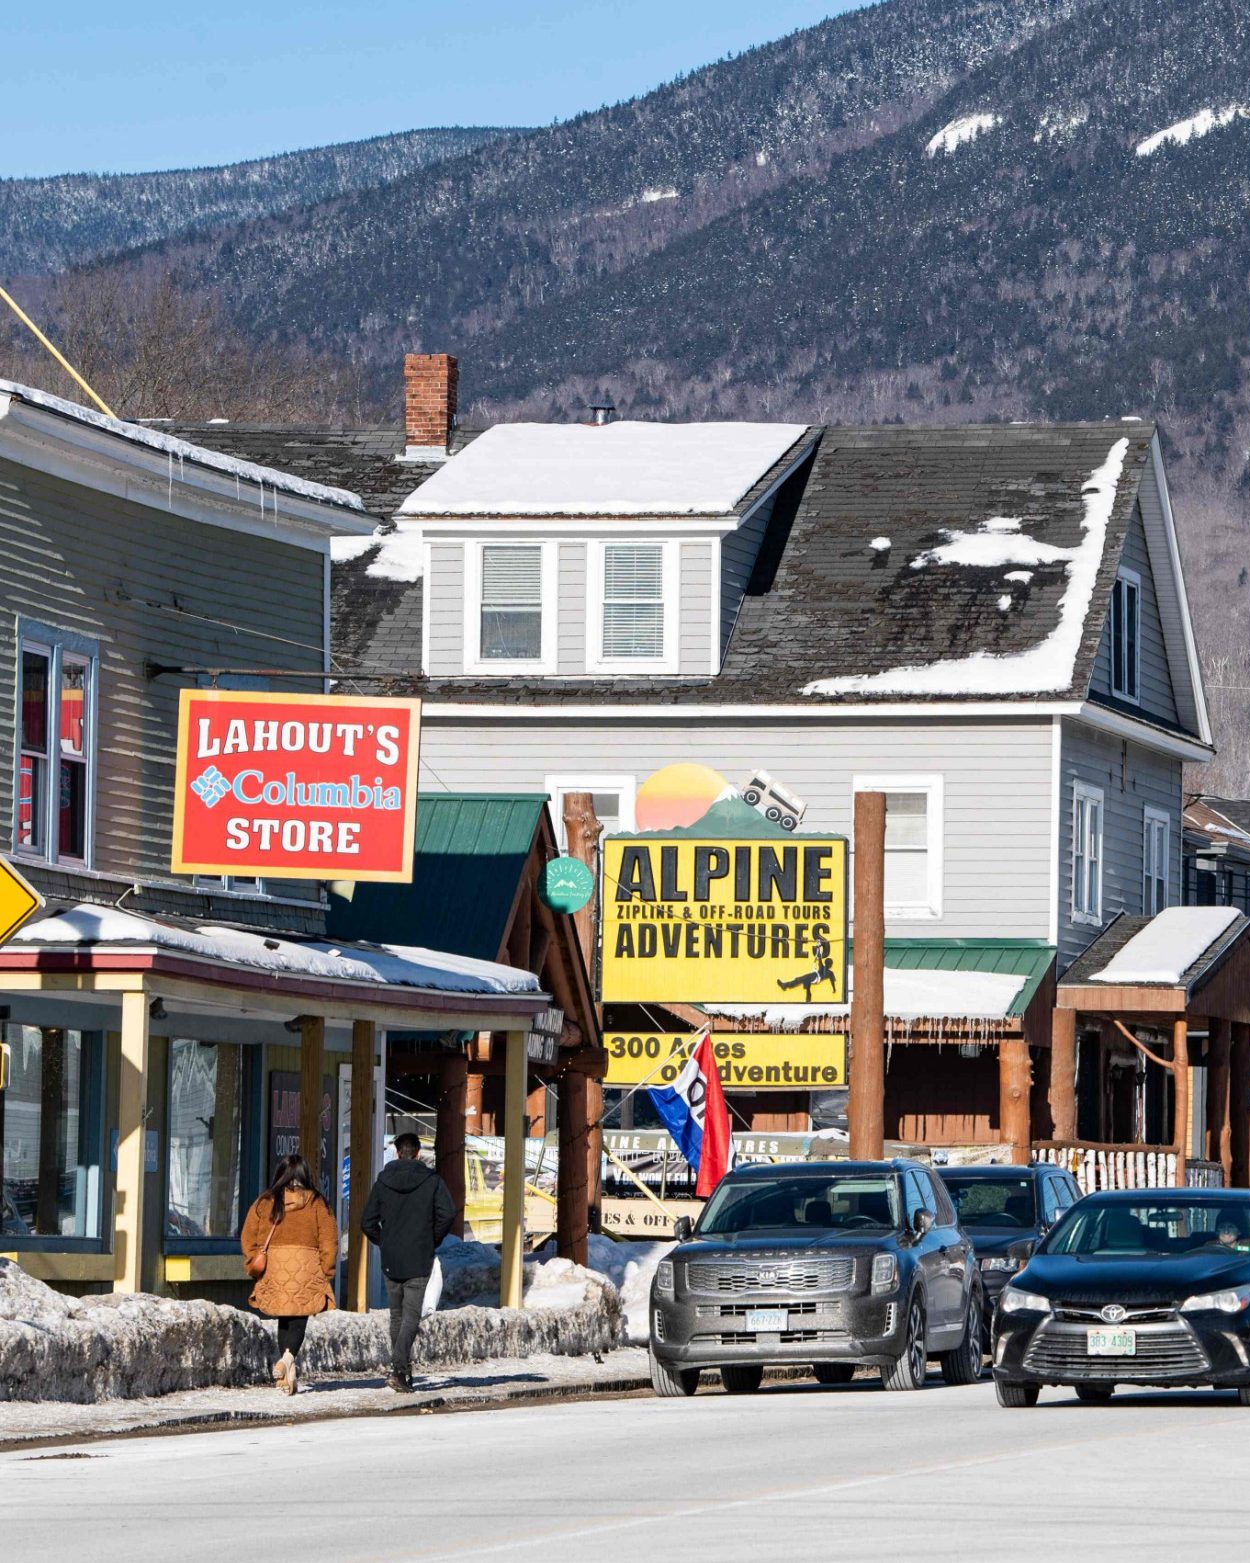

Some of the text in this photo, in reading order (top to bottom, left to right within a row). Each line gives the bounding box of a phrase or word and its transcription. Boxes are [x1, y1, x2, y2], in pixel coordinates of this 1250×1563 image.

[197, 718, 400, 766] LAHOUT'S
[232, 769, 402, 810] Columbia
[226, 817, 361, 854] STORE
[615, 846, 833, 902] ALPINE
[617, 905, 831, 919] ZIPLINE & OFF-ROAD TOURS
[615, 922, 831, 958] ADVENTURES
[610, 1037, 660, 1058] 300
[719, 1062, 837, 1082] dventure
